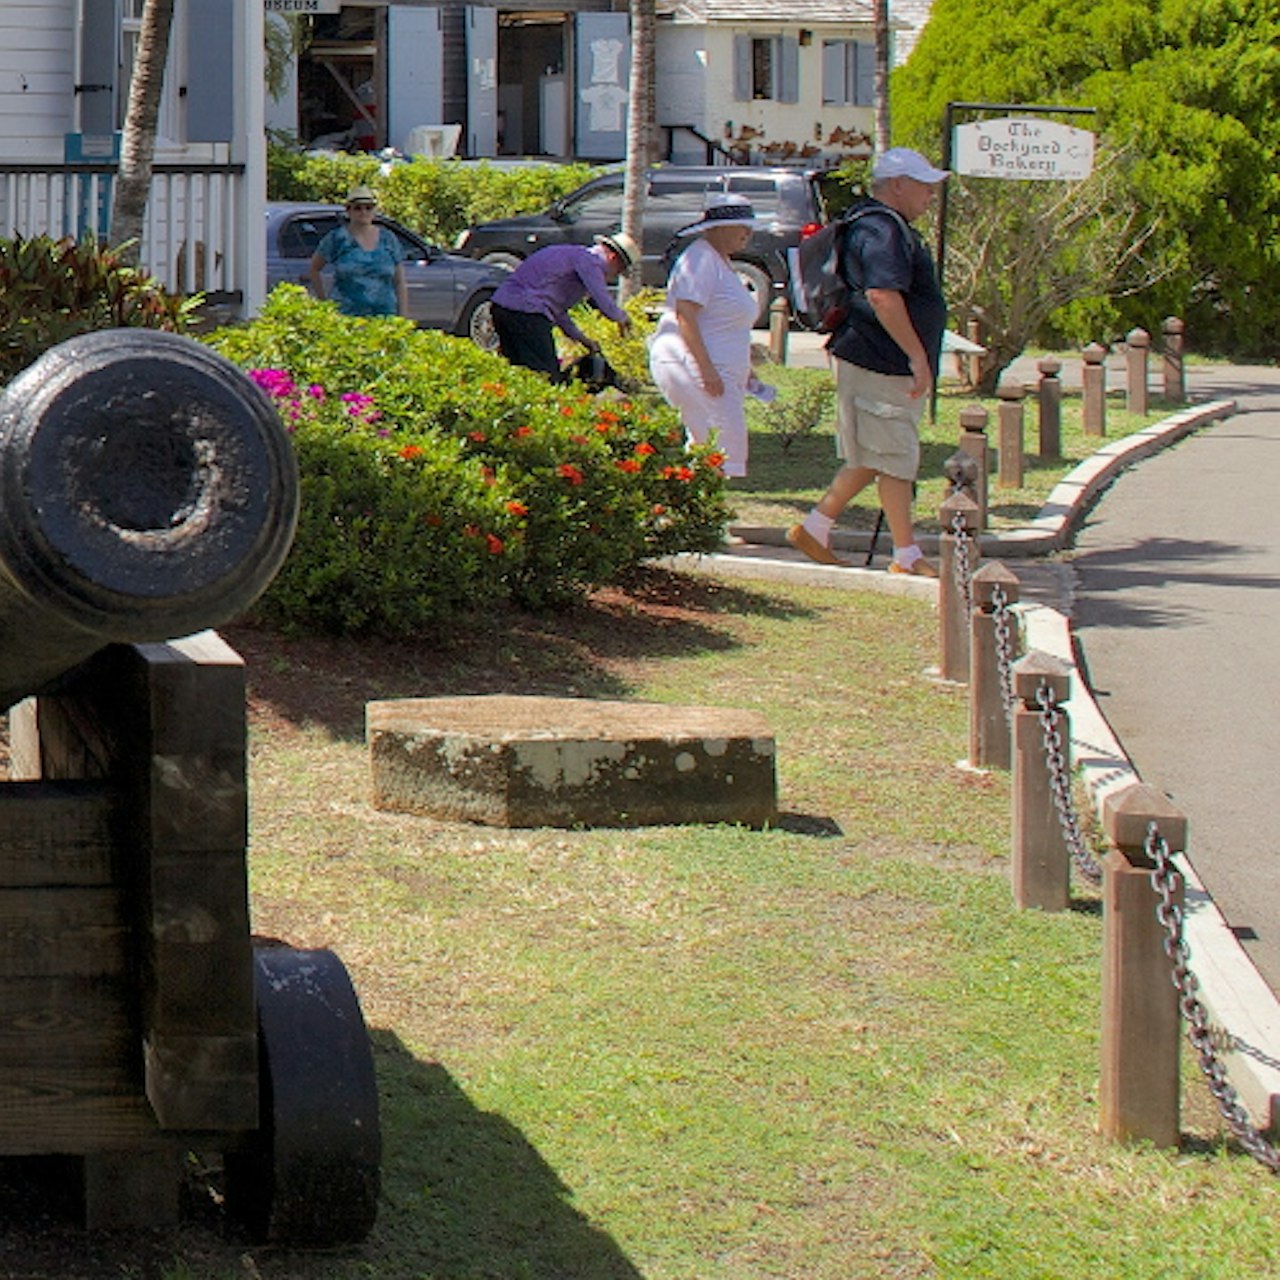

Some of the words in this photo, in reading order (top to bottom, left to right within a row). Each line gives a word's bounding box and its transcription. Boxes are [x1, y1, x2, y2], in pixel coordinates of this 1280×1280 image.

[264, 0, 318, 11] USEUM
[1007, 122, 1043, 137] The
[987, 152, 1057, 172] Bakery
